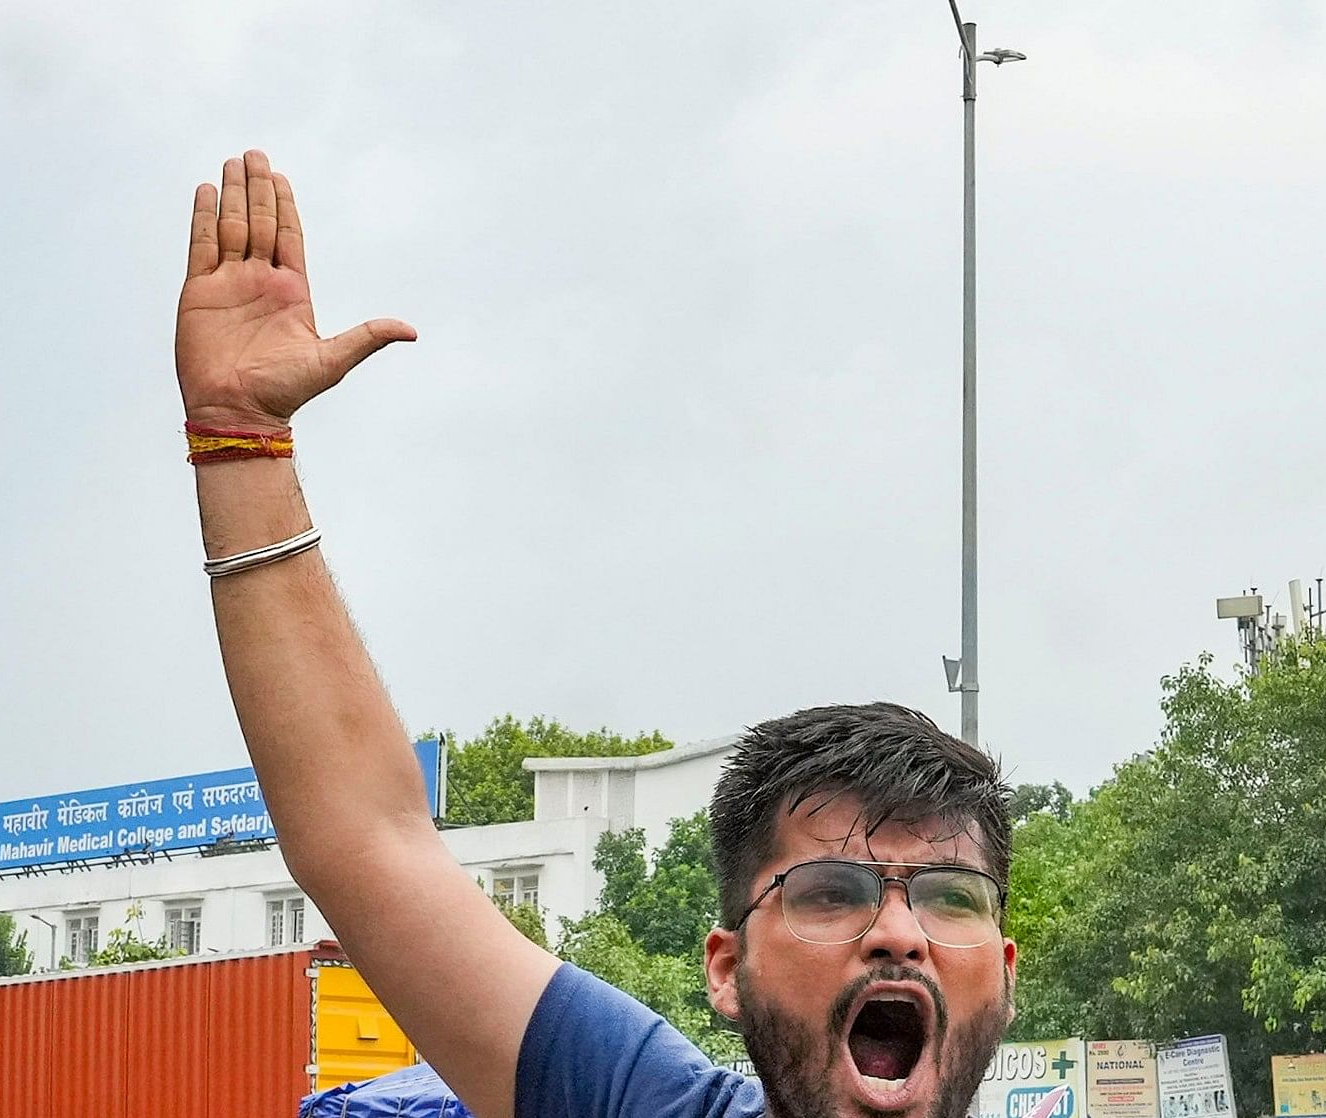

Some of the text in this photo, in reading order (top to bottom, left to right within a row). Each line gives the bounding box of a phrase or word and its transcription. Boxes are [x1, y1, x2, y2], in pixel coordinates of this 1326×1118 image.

[3, 804, 50, 836] महावीर
[57, 798, 109, 827] मेडिकल
[117, 789, 165, 819] कॉलेज
[172, 783, 195, 815] एवं
[202, 781, 260, 808] सफदरज
[0, 838, 54, 862] Mahavir
[57, 829, 113, 855] Medical
[117, 825, 174, 848] College
[177, 818, 207, 839] and
[1096, 1060, 1144, 1070] NATIONAL
[1186, 1045, 1220, 1057] Diagnostic
